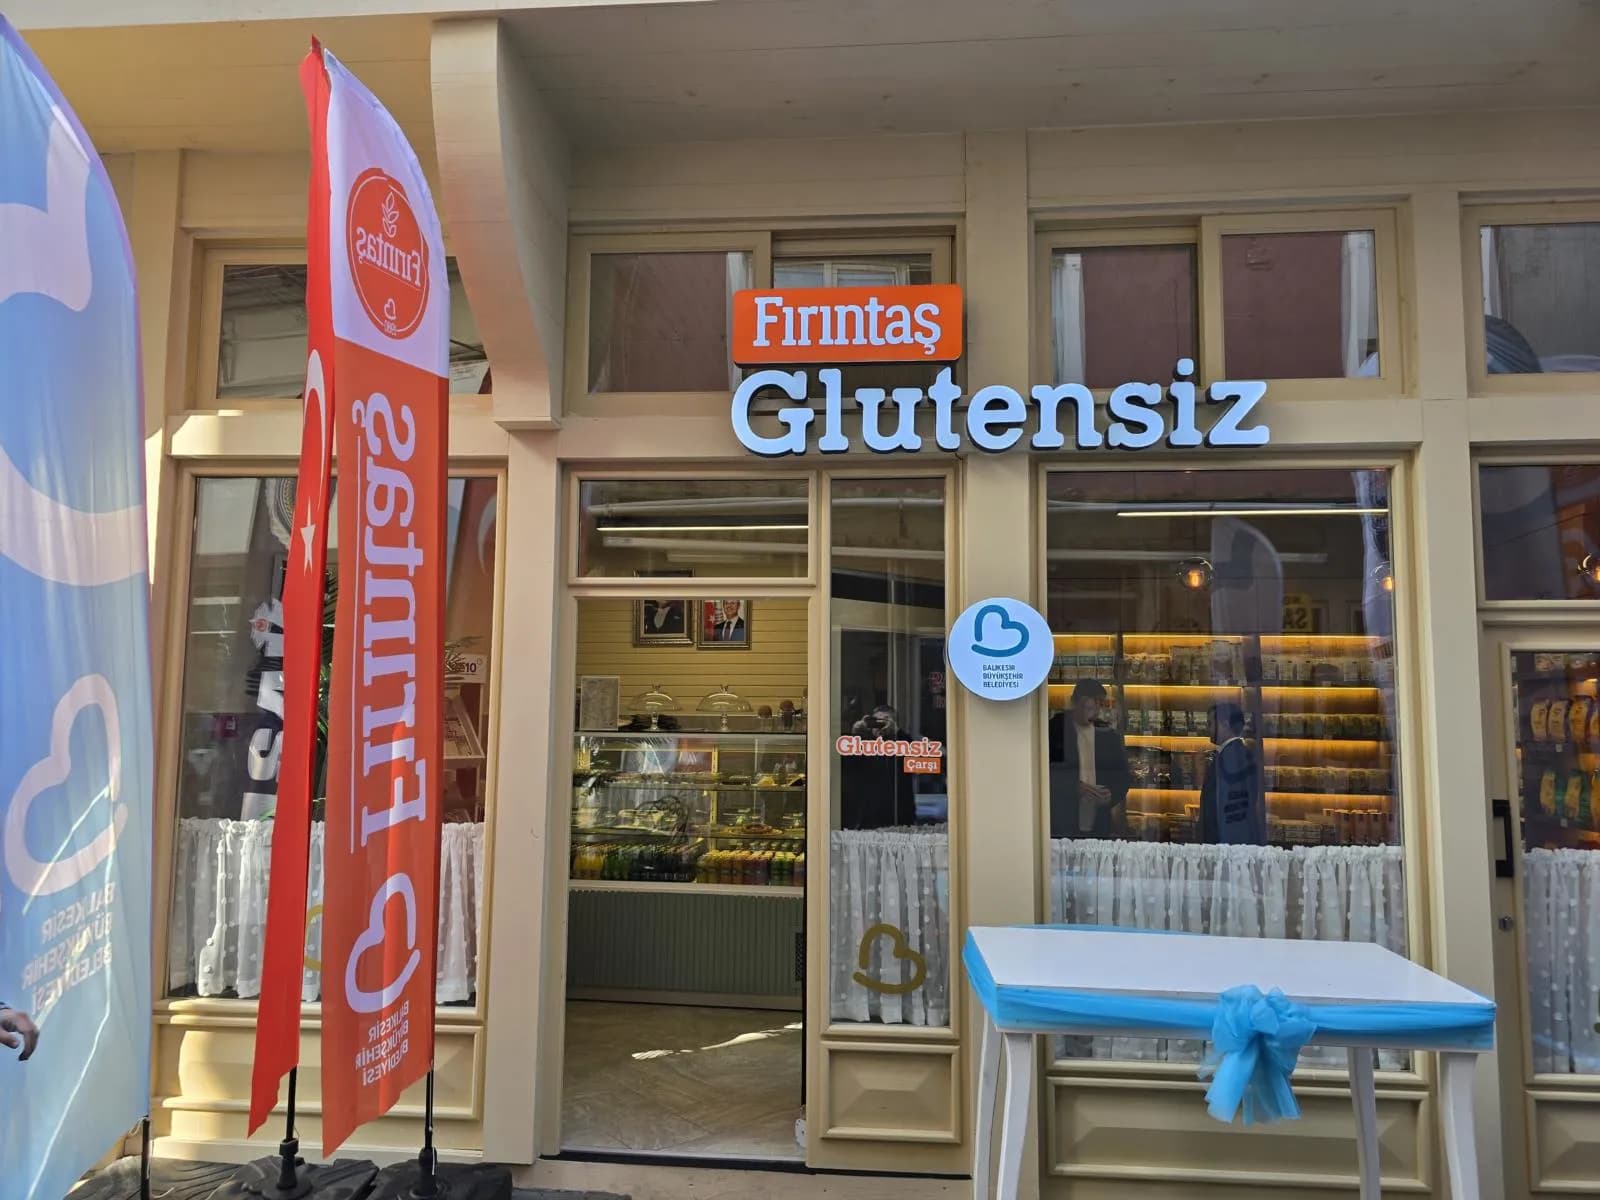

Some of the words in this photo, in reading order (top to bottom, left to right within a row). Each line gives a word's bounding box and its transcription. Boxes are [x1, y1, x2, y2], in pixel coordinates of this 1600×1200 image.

[753, 296, 941, 355] Fırıntaş
[731, 358, 1270, 454] Glutensiz
[836, 736, 942, 757] Glutensiz
[906, 759, 937, 773] Çarşı
